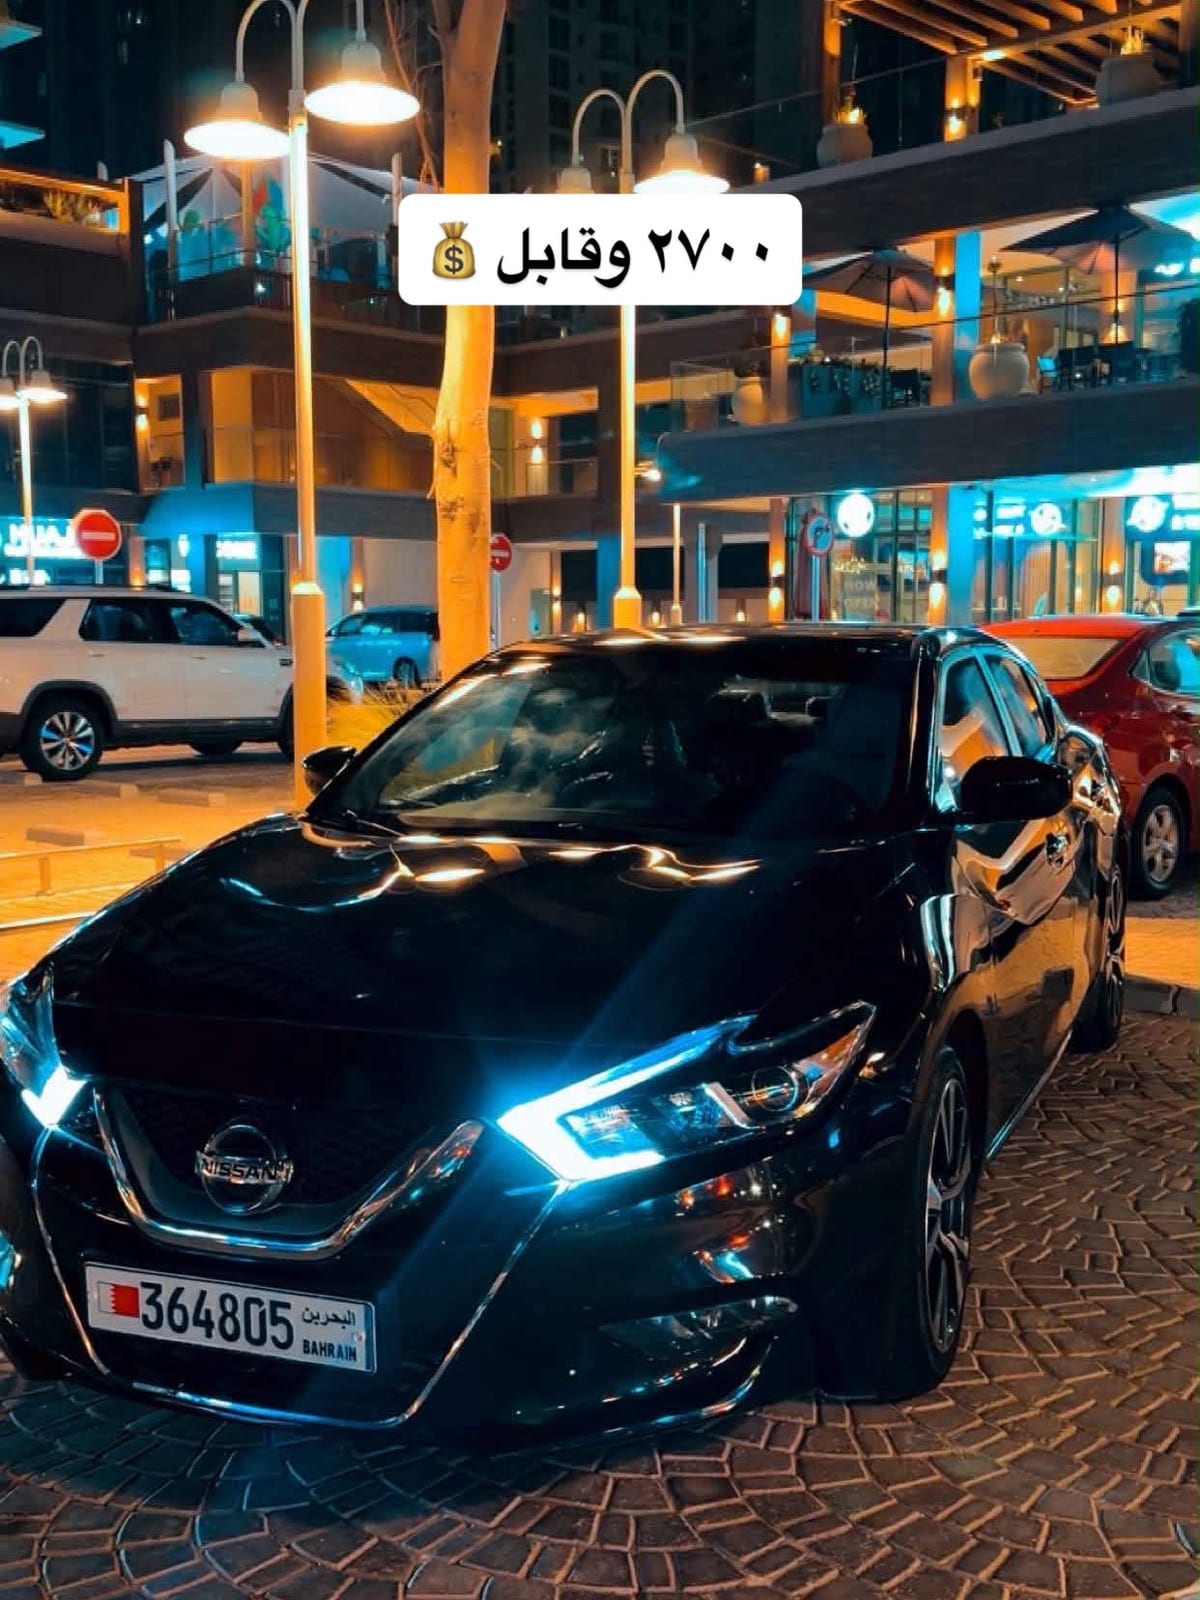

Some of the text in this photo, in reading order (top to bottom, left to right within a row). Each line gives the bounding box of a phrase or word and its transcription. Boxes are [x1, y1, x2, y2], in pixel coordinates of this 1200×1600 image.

[196, 1152, 294, 1184] NISSAN
[140, 1281, 295, 1350] 364805
[301, 1305, 357, 1330] البحرين
[302, 1338, 358, 1363] BAHRAIN
